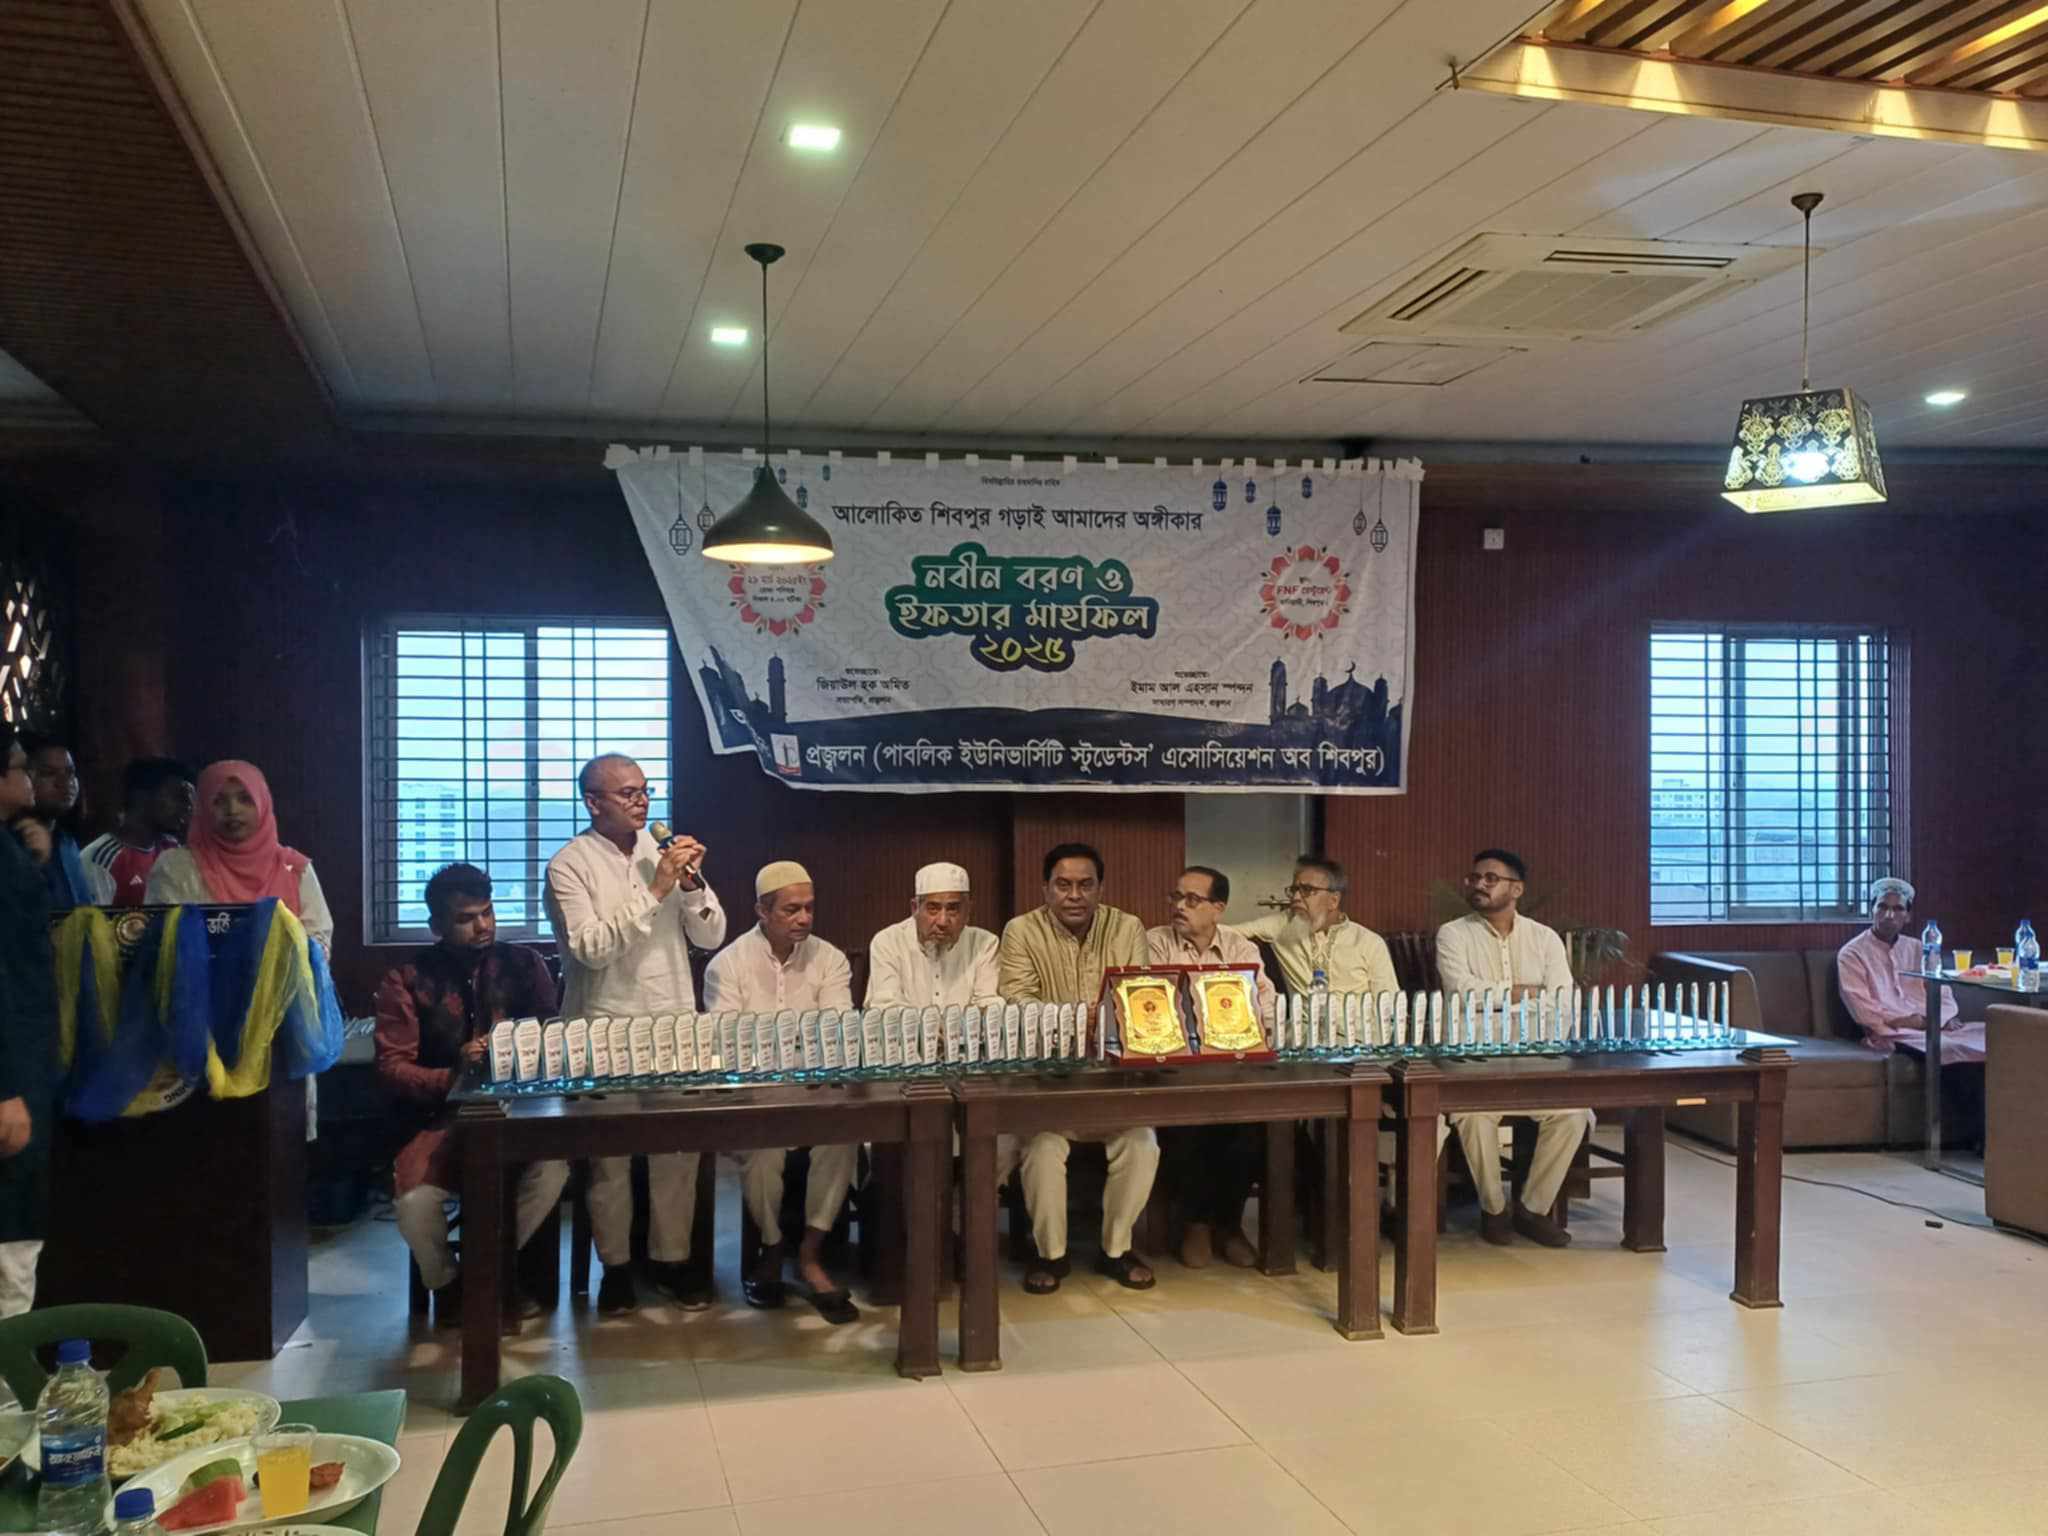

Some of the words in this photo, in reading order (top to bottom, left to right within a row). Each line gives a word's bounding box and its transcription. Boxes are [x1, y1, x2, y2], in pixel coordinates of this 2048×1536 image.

[832, 501, 923, 525] আলোকিত
[931, 501, 990, 530] শিবপুর
[999, 503, 1046, 531] গড়াই
[1052, 508, 1126, 529] আমাদের
[1133, 505, 1203, 531] অঙ্গীকার
[921, 551, 1002, 589] নবীন
[1013, 564, 1085, 592] বরণ
[1096, 568, 1125, 592] ও
[1277, 585, 1299, 595] FNF
[895, 595, 1011, 631] ইফতার
[1023, 595, 1150, 631] মাহফিল
[980, 634, 1066, 664] ২০২৫
[861, 680, 877, 691] হক
[1131, 680, 1156, 693] ইমাম
[1159, 683, 1179, 693] আল
[1184, 683, 1218, 693] এহসান
[805, 744, 867, 774] প্রজ্বলন
[873, 738, 953, 773] (পাবলিক
[958, 738, 1065, 770] ইউনিভার্সিটি
[1161, 740, 1275, 770] এসোসিয়েশন
[1280, 747, 1312, 769] অব
[1318, 741, 1385, 776] শিবপুর)
